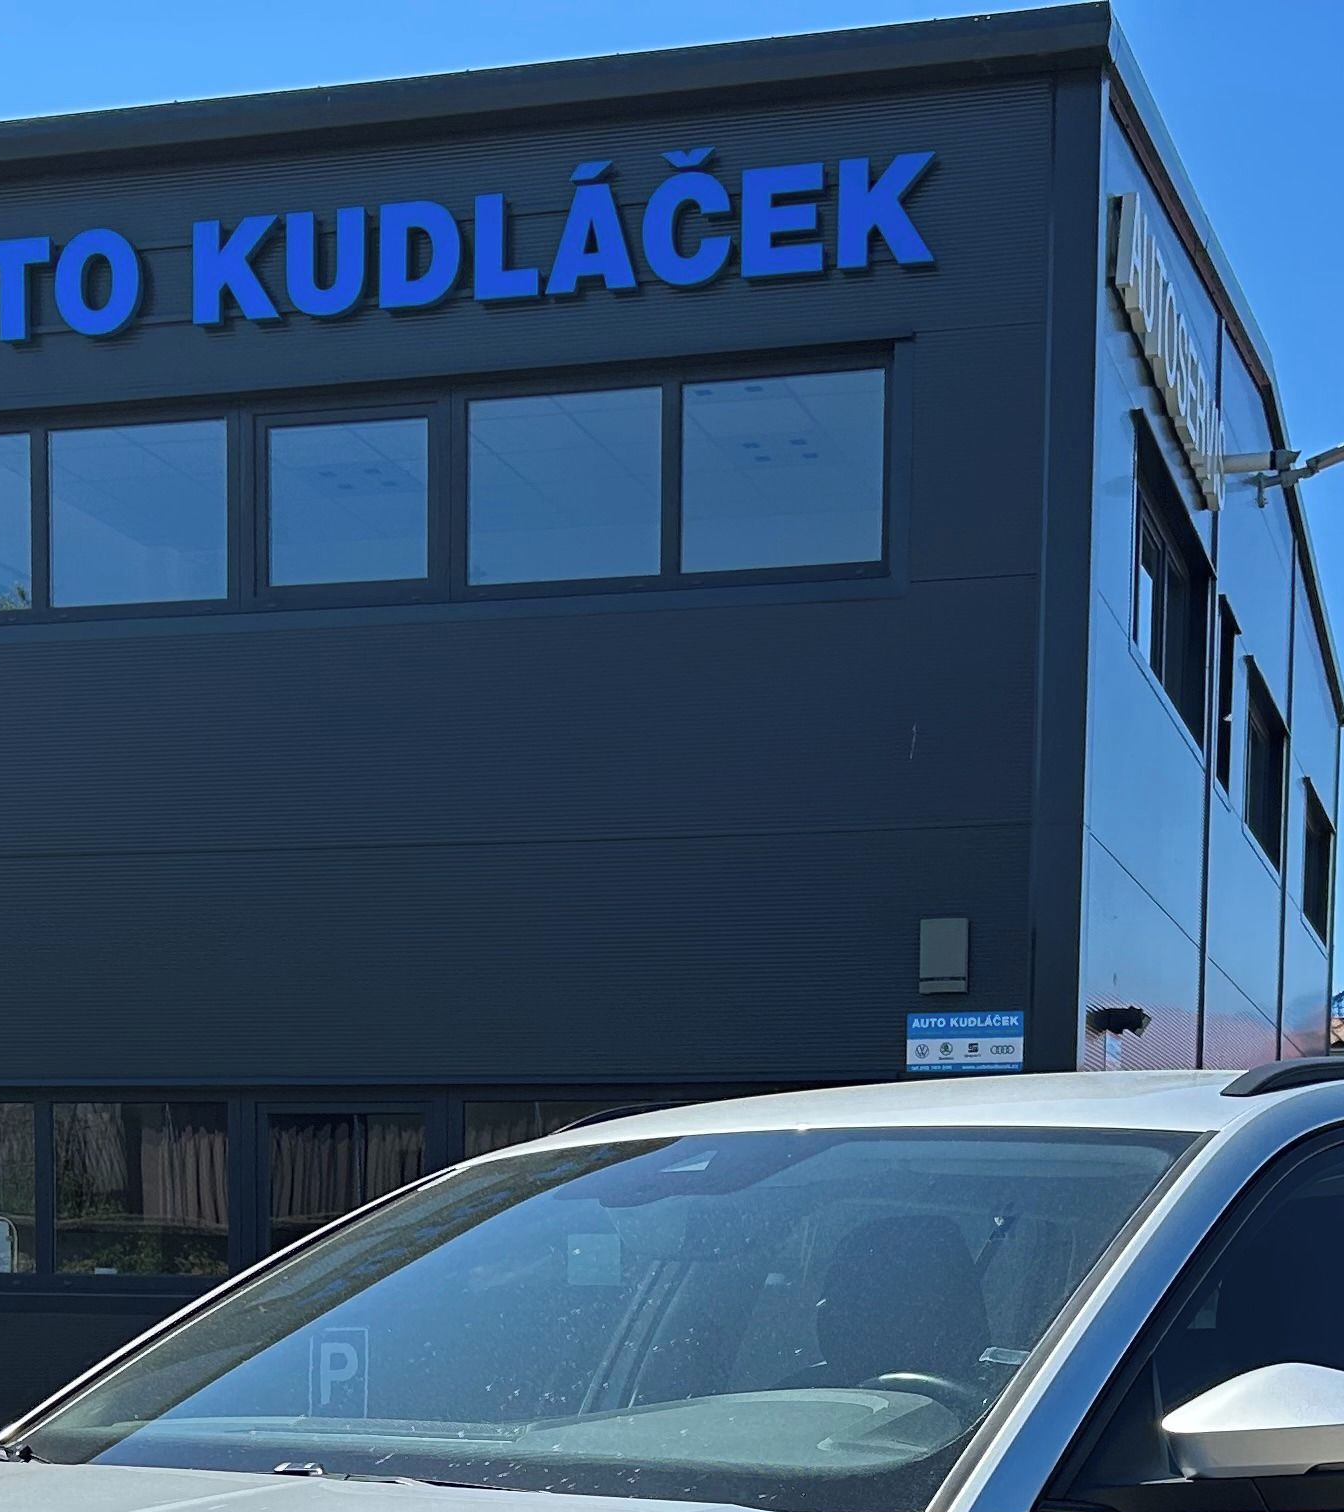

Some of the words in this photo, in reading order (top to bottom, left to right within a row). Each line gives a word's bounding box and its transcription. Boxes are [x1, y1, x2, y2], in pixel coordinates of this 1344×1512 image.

[192, 147, 937, 325] KUDLÁČEK
[912, 1017, 946, 1029] AUTO
[950, 1014, 1019, 1028] KUDLÁČEK
[320, 1342, 358, 1405] P
